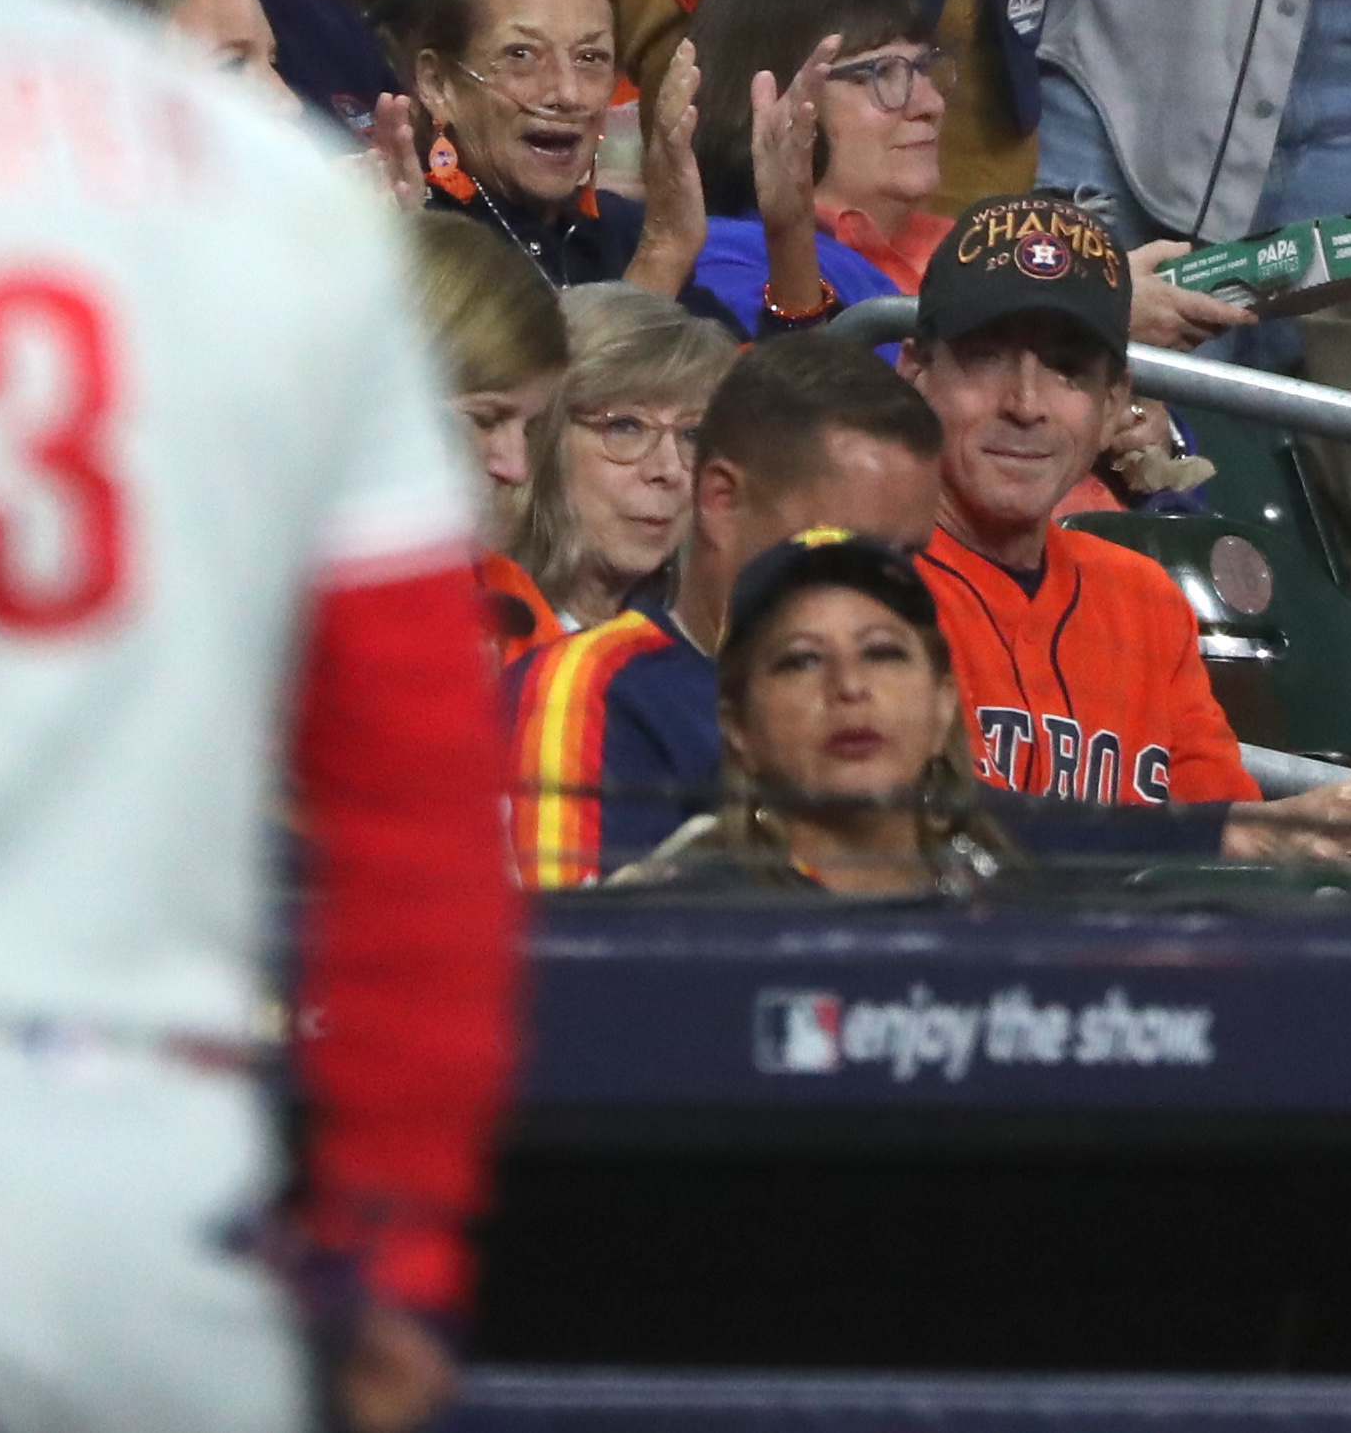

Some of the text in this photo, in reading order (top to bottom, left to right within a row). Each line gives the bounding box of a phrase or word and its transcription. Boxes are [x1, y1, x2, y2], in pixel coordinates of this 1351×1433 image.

[972, 200, 1049, 225] WORLD
[957, 211, 1121, 289] CHAMPS
[1257, 239, 1298, 266] PAPA
[846, 982, 982, 1082] enjoy
[986, 985, 1072, 1063] the
